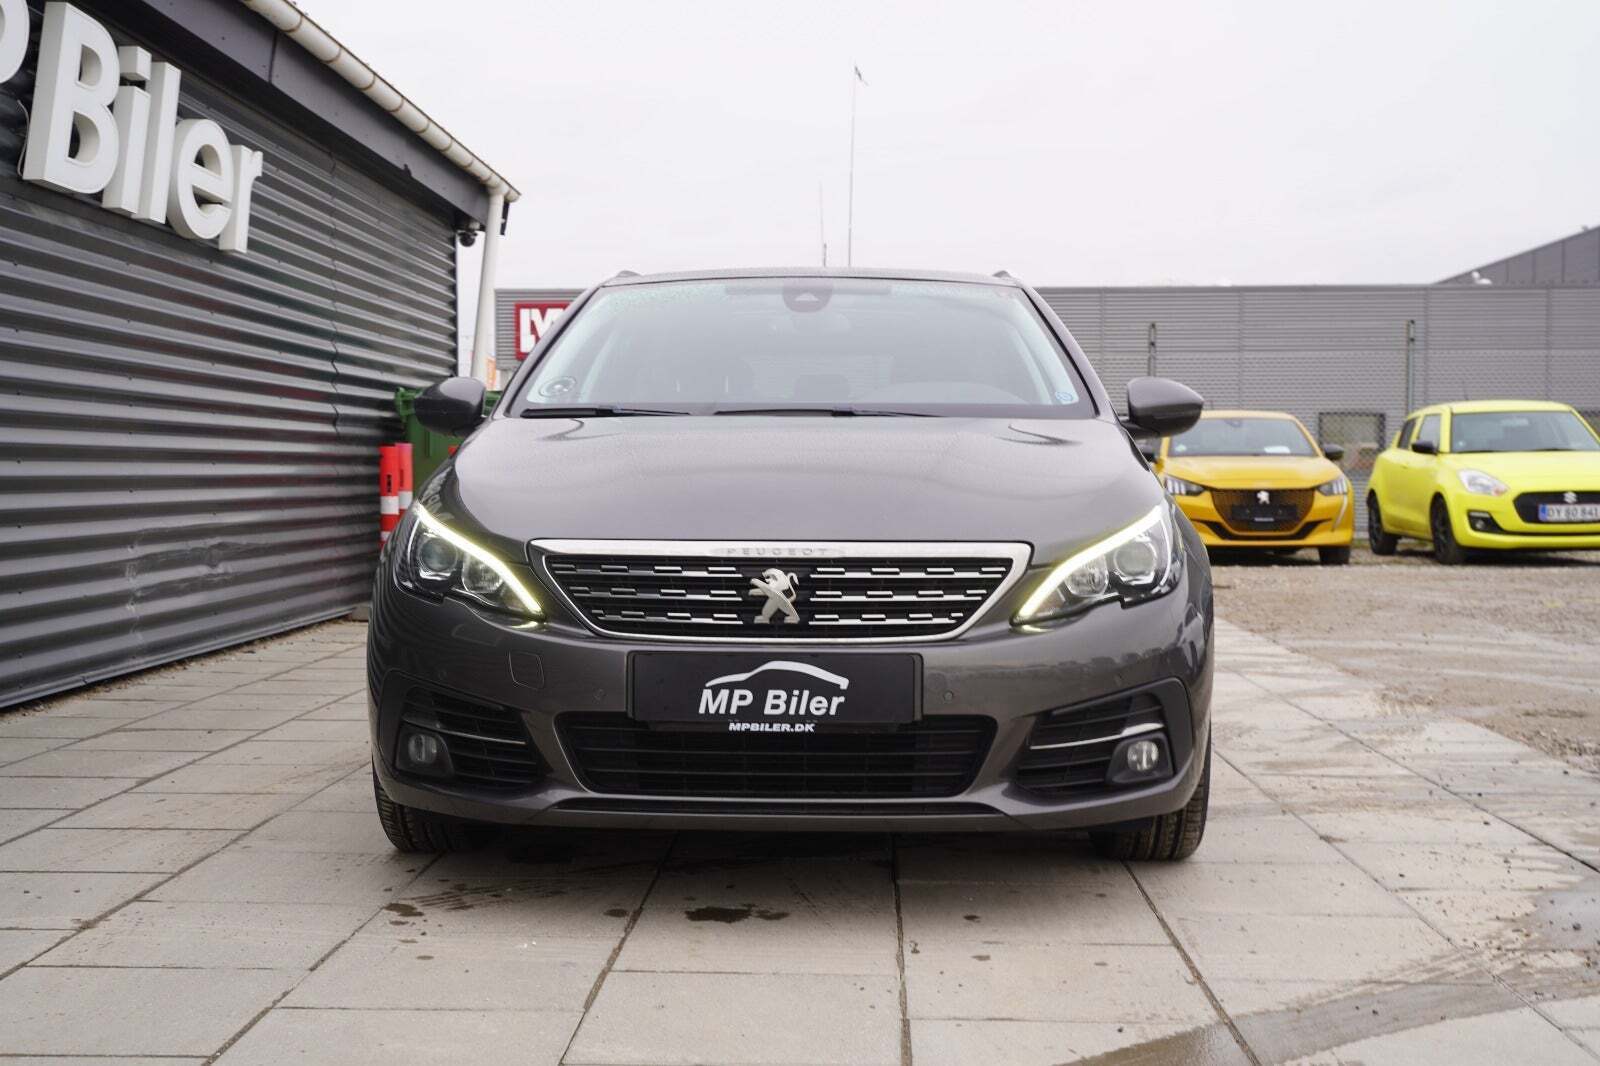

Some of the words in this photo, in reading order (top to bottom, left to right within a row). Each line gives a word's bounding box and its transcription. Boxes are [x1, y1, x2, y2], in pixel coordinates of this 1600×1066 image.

[23, 2, 263, 253] Biler
[727, 547, 828, 556] PEUGEOT
[698, 688, 753, 715] MP
[763, 689, 845, 716] Biler
[728, 722, 816, 733] MPBILER.DK
